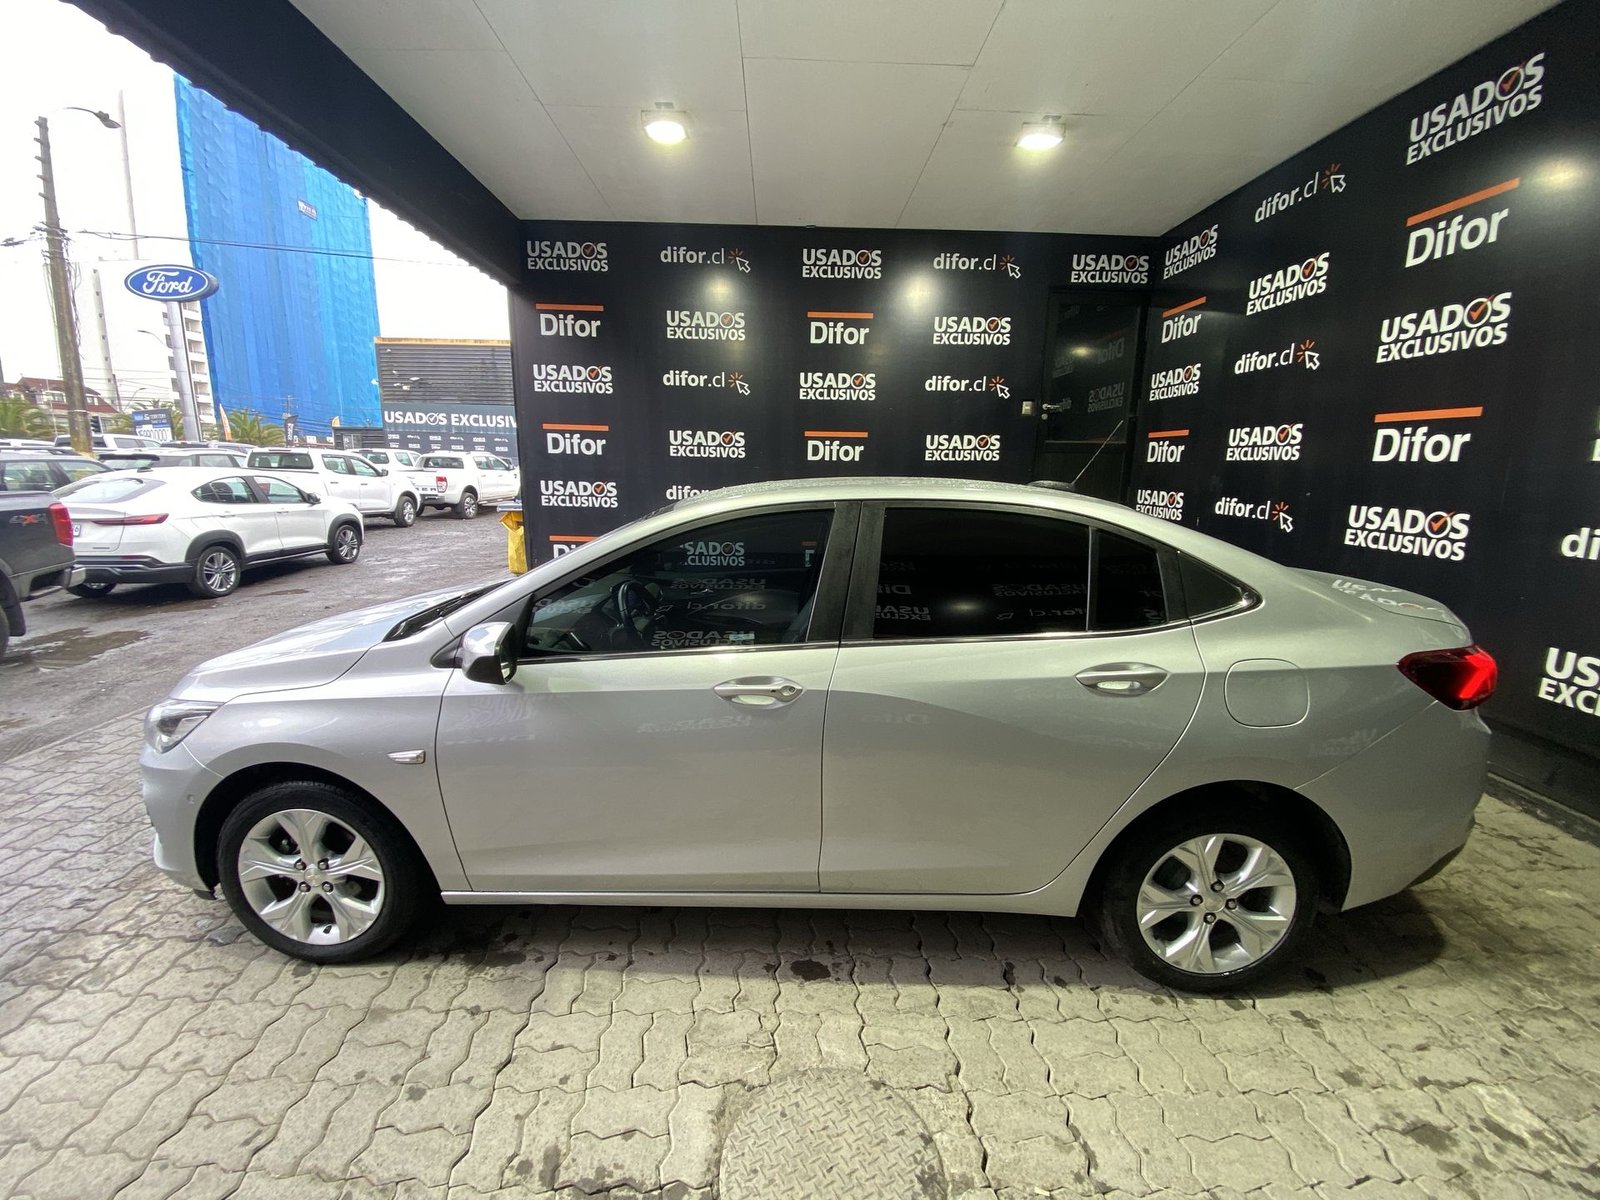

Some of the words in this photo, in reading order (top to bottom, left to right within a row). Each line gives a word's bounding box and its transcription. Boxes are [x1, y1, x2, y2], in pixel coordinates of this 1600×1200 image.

[1410, 53, 1544, 142] USADOS
[1406, 86, 1543, 166] EXCLUSIVOS
[1254, 172, 1319, 224] difor.cl
[1165, 224, 1218, 266] USADOS
[1405, 208, 1509, 268] Difor
[527, 241, 607, 258] USADOS
[660, 246, 724, 264] difor.cl
[802, 248, 882, 267] USADOS
[528, 258, 608, 272] EXCLUSIVOS
[933, 253, 996, 271] difor.cl
[1072, 254, 1149, 272] USADOS
[1164, 244, 1216, 280] EXCLUSIVOS
[802, 266, 882, 279] EXCLUSIVOS
[1071, 271, 1148, 284] EXCLUSIVOS
[1248, 252, 1330, 300] USADOS
[142, 271, 193, 293] Ford
[1246, 276, 1326, 316] EXCLUSIVOS
[540, 313, 600, 337] Difor
[666, 310, 744, 328] USADOS
[934, 316, 1011, 334] USADOS
[1380, 292, 1512, 344] USADOS
[666, 327, 745, 340] EXCLUSIVOS
[810, 321, 869, 344] Difor
[1162, 313, 1201, 344] Difor
[933, 333, 1010, 346] EXCLUSIVOS
[1376, 322, 1508, 364] EXCLUSIVOS
[1234, 343, 1294, 375] difor.cl
[533, 364, 612, 382] USADOS
[662, 370, 725, 388] difor.cl
[800, 372, 876, 390] USADOS
[1152, 364, 1201, 388] USADOS
[534, 382, 613, 394] EXCLUSIVOS
[925, 376, 986, 392] difor.cl
[1150, 381, 1200, 402] EXCLUSIVOS
[800, 388, 876, 400] EXCLUSIVOS
[384, 411, 447, 425] USADOS
[451, 414, 517, 428] EXCLUSIV
[546, 433, 606, 455] Difor
[669, 430, 744, 447] USADOS
[926, 434, 1000, 451] USADOS
[1228, 424, 1302, 448] USADOS
[1372, 426, 1471, 462] Difor
[670, 446, 745, 458] EXCLUSIVOS
[807, 440, 864, 461] Difor
[924, 450, 1000, 461] EXCLUSIVOS
[1147, 441, 1184, 464] Difor
[1226, 446, 1300, 462] EXCLUSIVOS
[540, 480, 617, 497] USADOS
[541, 496, 618, 508] EXCLUSIVOS
[1137, 490, 1184, 508] USADOS
[1136, 504, 1182, 520] EXCLUSIVOS
[1215, 498, 1270, 521] difor.cl
[1348, 505, 1470, 540] USADOS
[680, 541, 745, 556] SADOS
[1344, 529, 1466, 562] EXCLUSIVOS
[684, 556, 745, 567] CLUSIVOS
